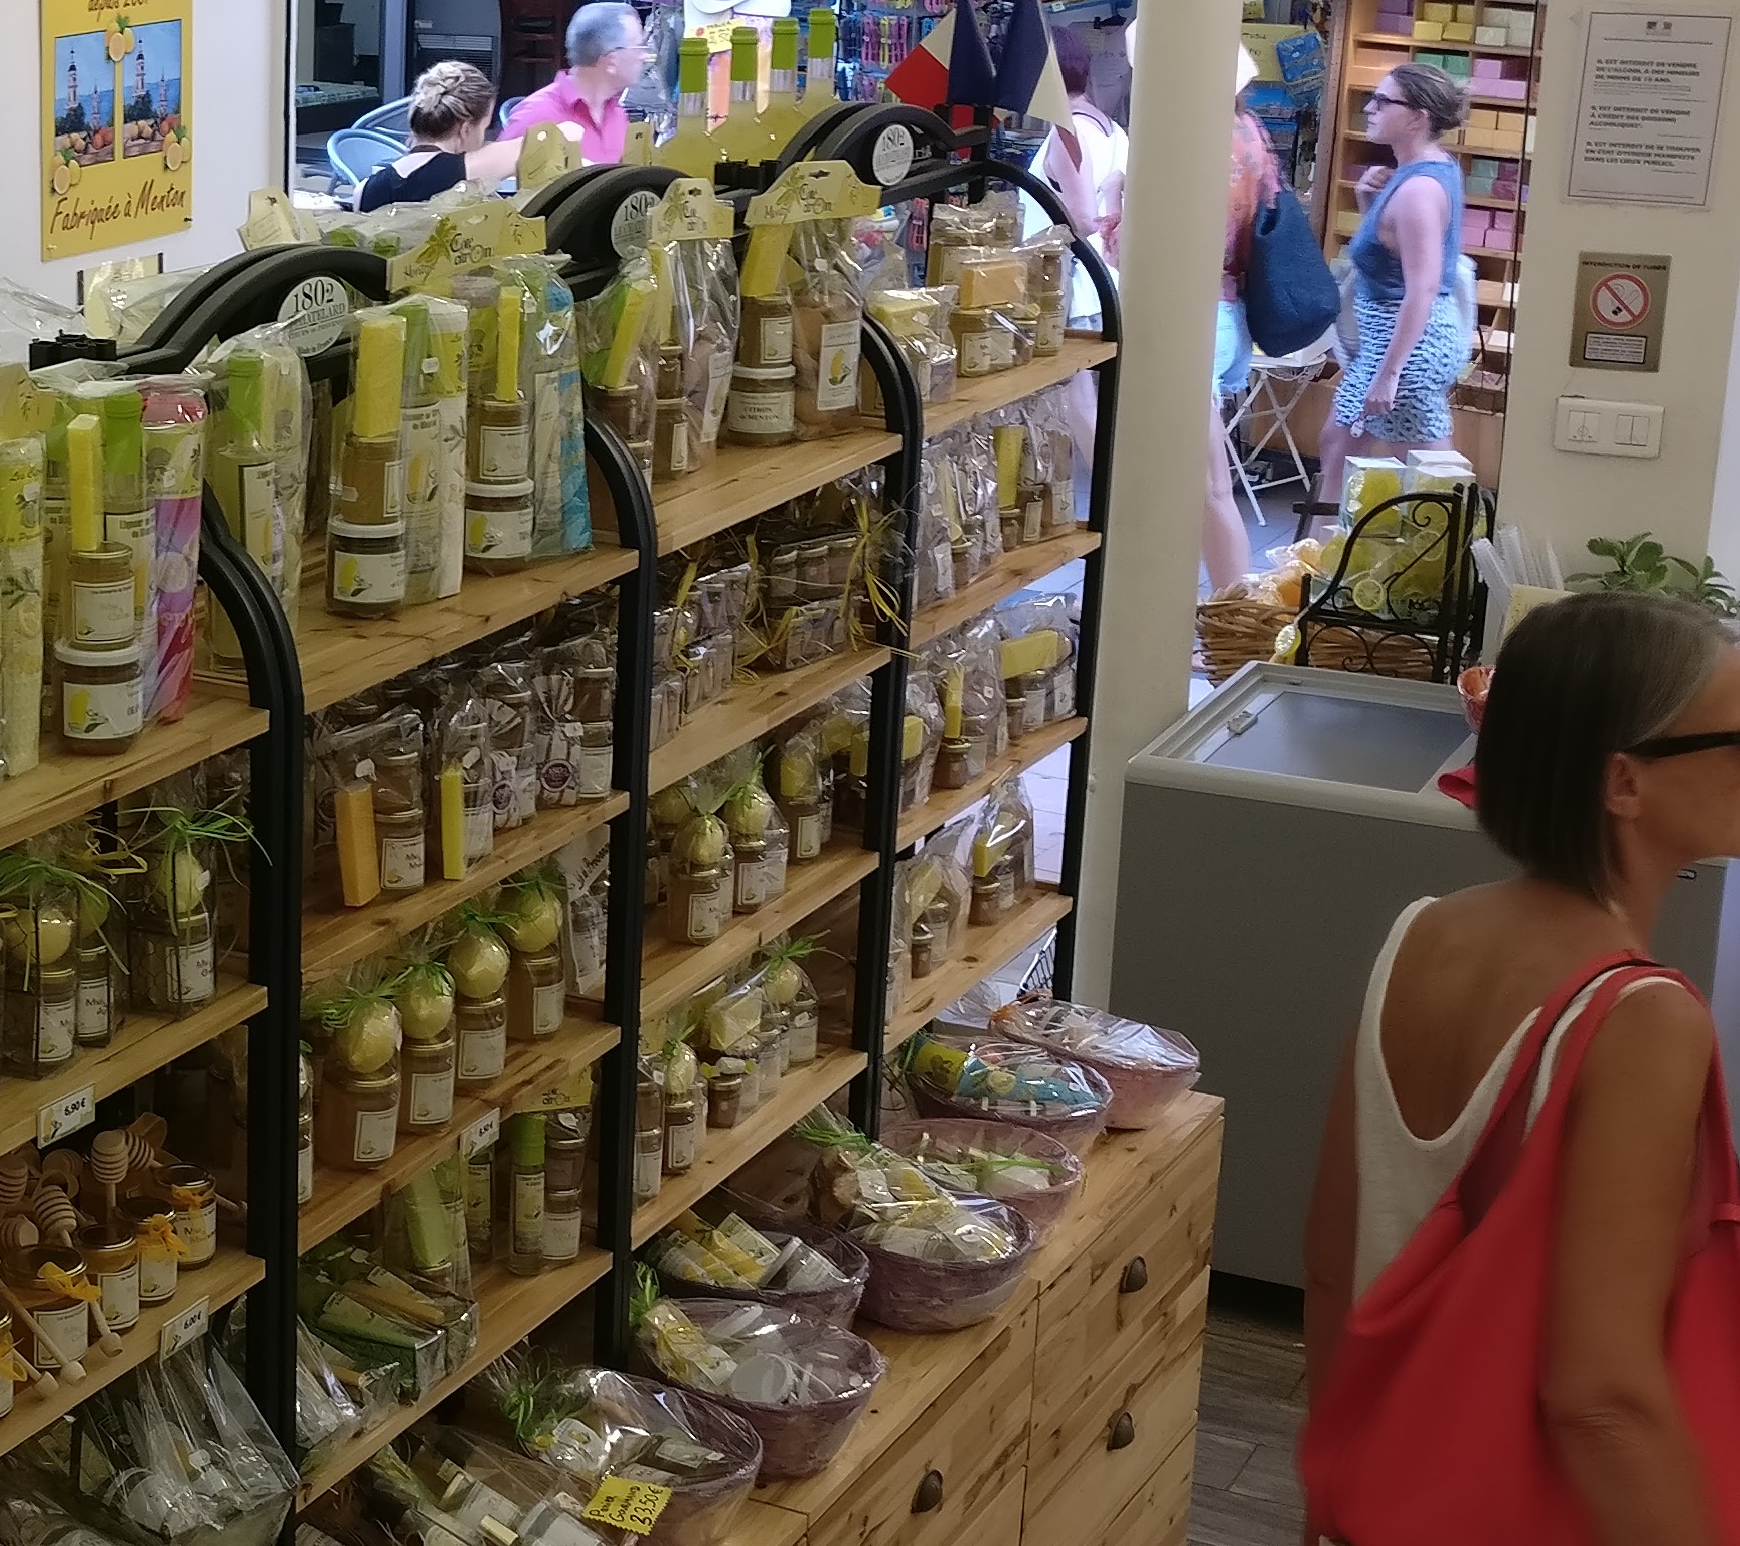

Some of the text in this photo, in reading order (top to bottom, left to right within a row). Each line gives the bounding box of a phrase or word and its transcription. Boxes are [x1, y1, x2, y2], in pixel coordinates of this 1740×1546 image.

[50, 178, 186, 240] Fabriquée à Menton
[293, 280, 334, 313] 1802
